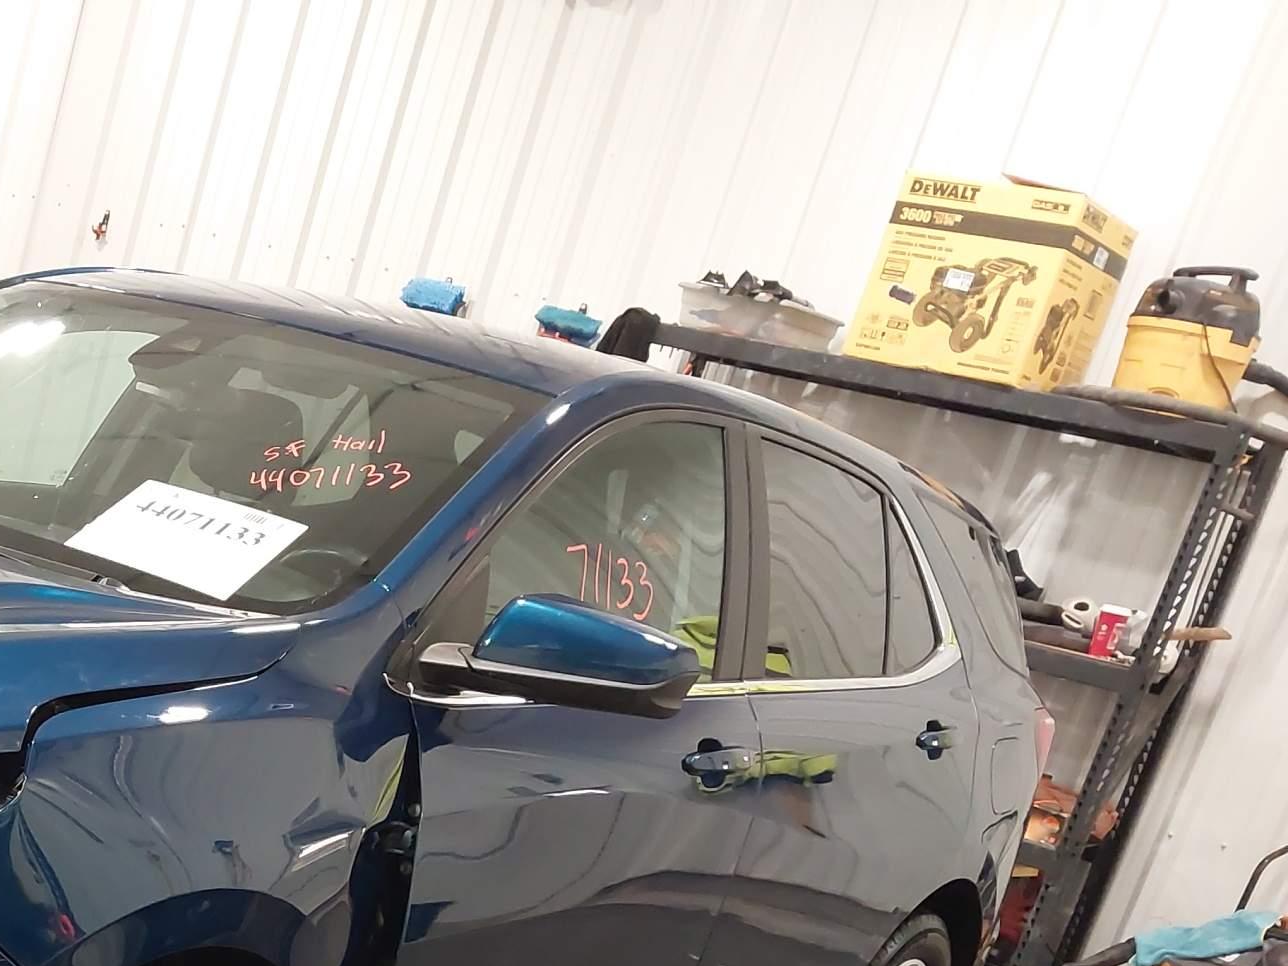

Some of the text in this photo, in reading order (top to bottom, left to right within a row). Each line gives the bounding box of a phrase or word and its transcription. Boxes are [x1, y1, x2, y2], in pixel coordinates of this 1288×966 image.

[899, 206, 932, 224] 3600
[249, 462, 412, 493] 44071133
[136, 500, 266, 546] 44071133
[566, 543, 654, 621] 71133
